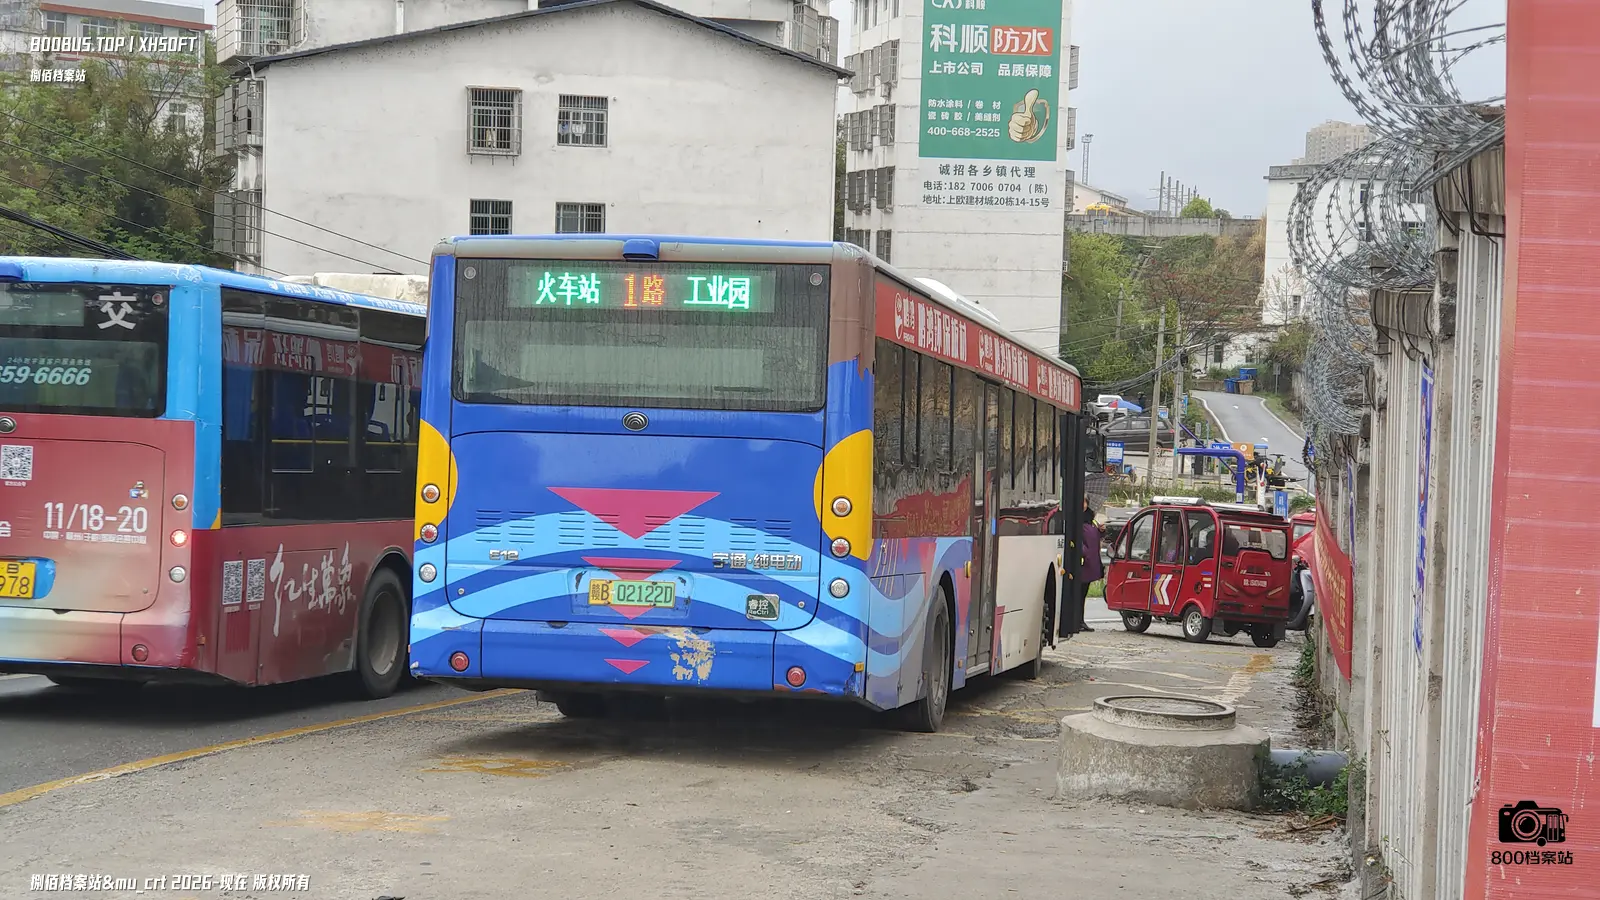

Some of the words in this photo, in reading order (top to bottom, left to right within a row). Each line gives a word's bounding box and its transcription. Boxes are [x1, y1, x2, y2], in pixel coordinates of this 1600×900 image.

[929, 61, 984, 76] 上市公司
[998, 63, 1052, 78] 品质保障
[928, 99, 963, 109] 防水涂料
[974, 112, 1001, 122] 美缝剂
[927, 127, 1000, 137] 400-668-2525
[939, 164, 1036, 178] 诚招各乡镇代理
[970, 182, 994, 192] 7006
[998, 183, 1022, 193] 0704
[535, 271, 601, 306] 火车站
[683, 275, 750, 309] 工业园
[97, 291, 138, 330] 交
[44, 502, 148, 533] 11/18-20
[489, 549, 519, 561] E12
[748, 599, 769, 610] 睿控
